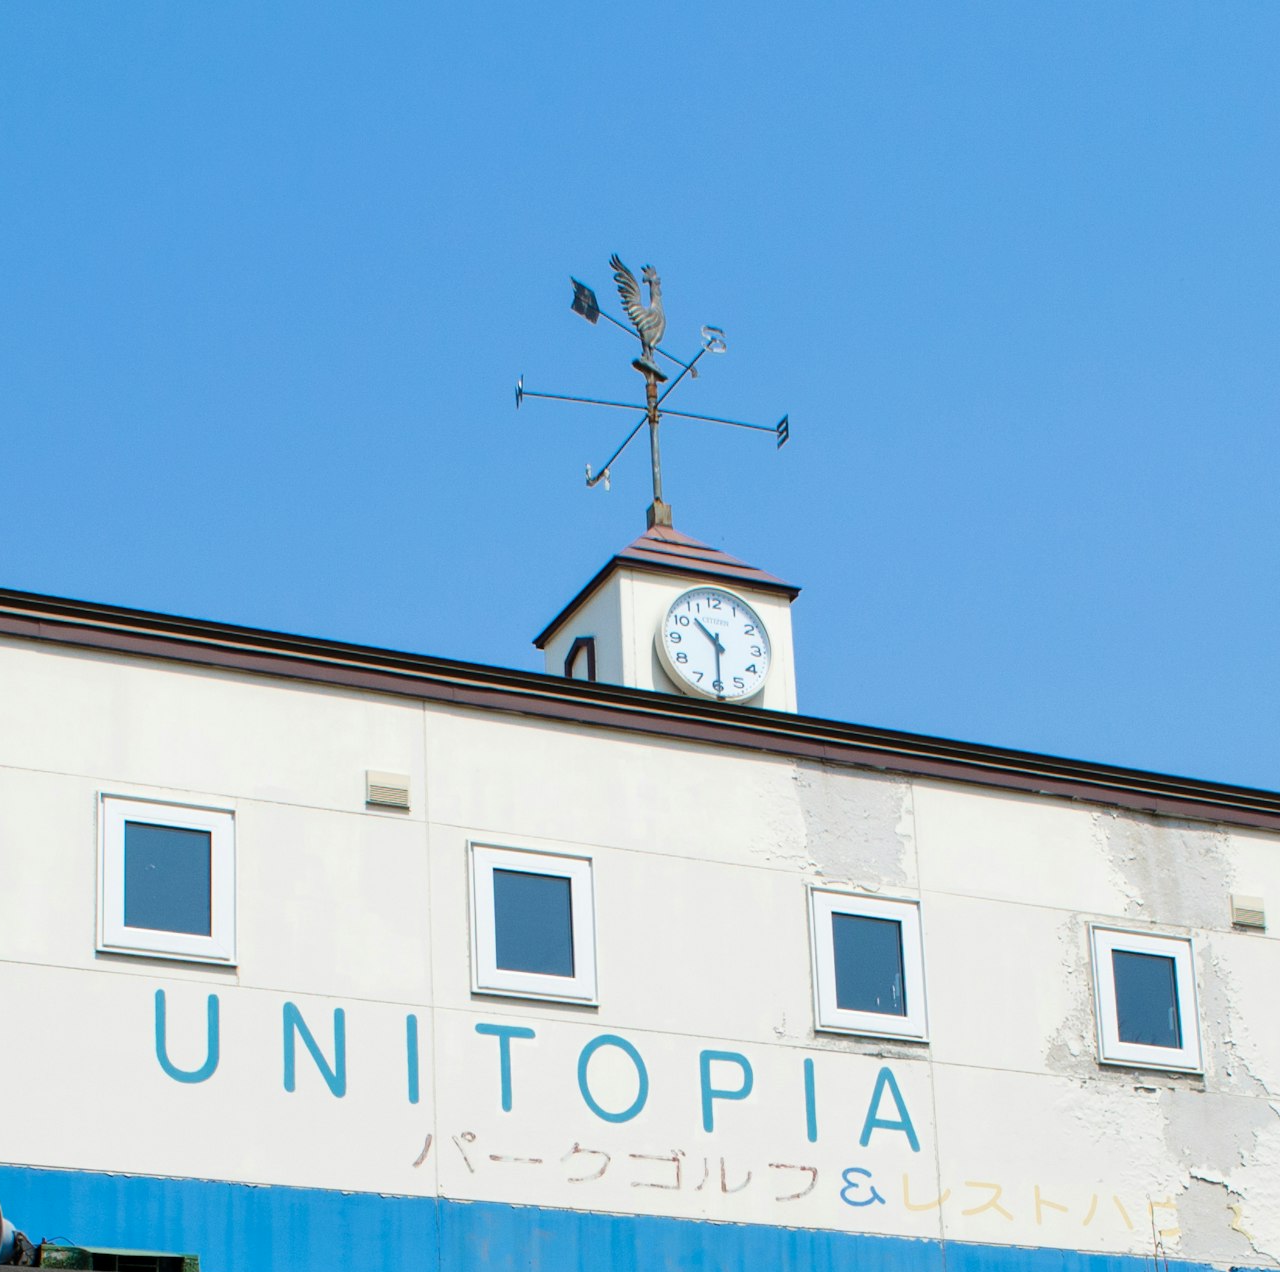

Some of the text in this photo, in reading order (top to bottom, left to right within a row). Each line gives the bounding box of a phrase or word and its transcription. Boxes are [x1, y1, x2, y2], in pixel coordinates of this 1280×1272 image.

[687, 601, 700, 614] 11
[706, 597, 721, 610] 12
[674, 614, 690, 627] 10
[744, 624, 755, 636] 2
[669, 631, 682, 644] 9
[676, 652, 688, 664] 8
[750, 645, 762, 658] 3
[745, 664, 758, 675] 4
[692, 670, 704, 683] 7
[733, 677, 745, 689] 5
[712, 680, 724, 692] 6
[154, 988, 922, 1153] UNITOPIA
